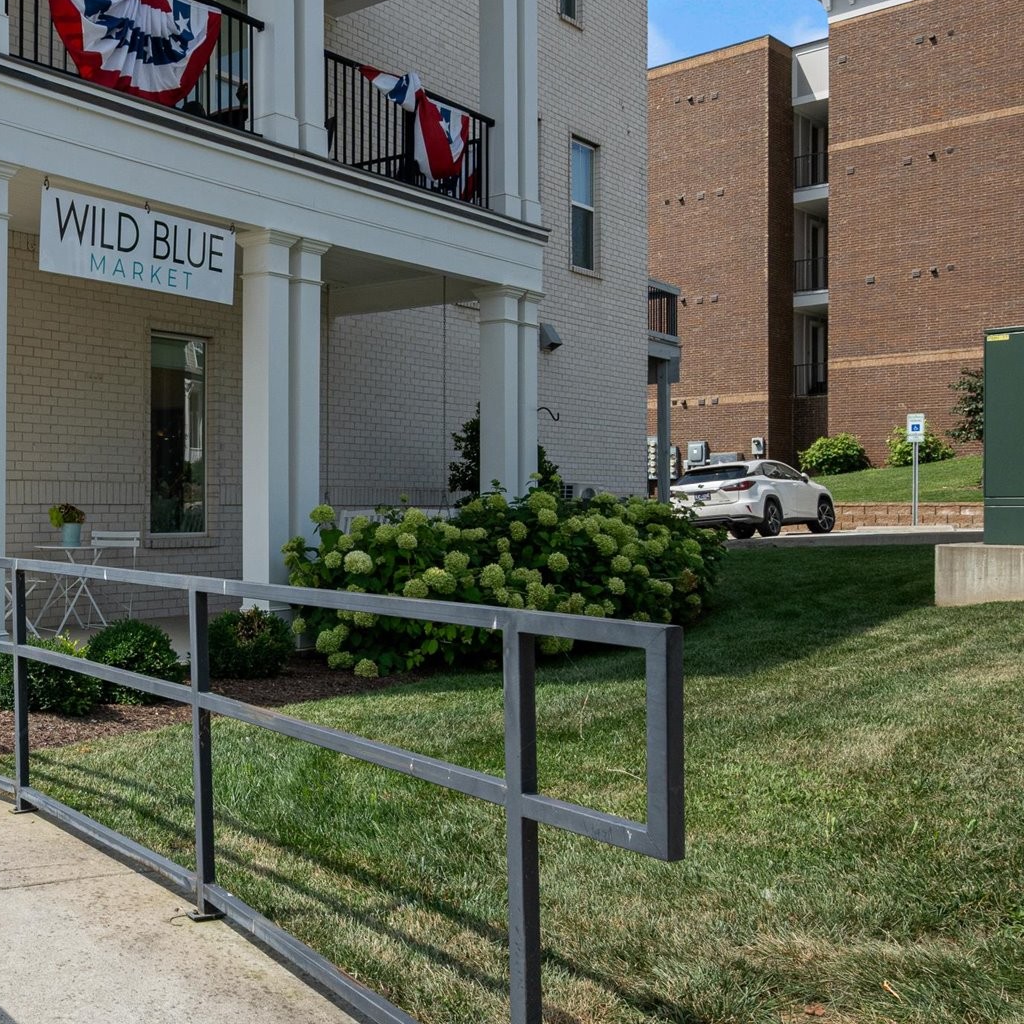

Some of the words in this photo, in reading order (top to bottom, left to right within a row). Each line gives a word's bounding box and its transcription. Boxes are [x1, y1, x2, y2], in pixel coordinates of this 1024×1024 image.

[55, 197, 140, 253] WILD
[152, 220, 224, 273] BLUE
[89, 253, 193, 290] MARKET
